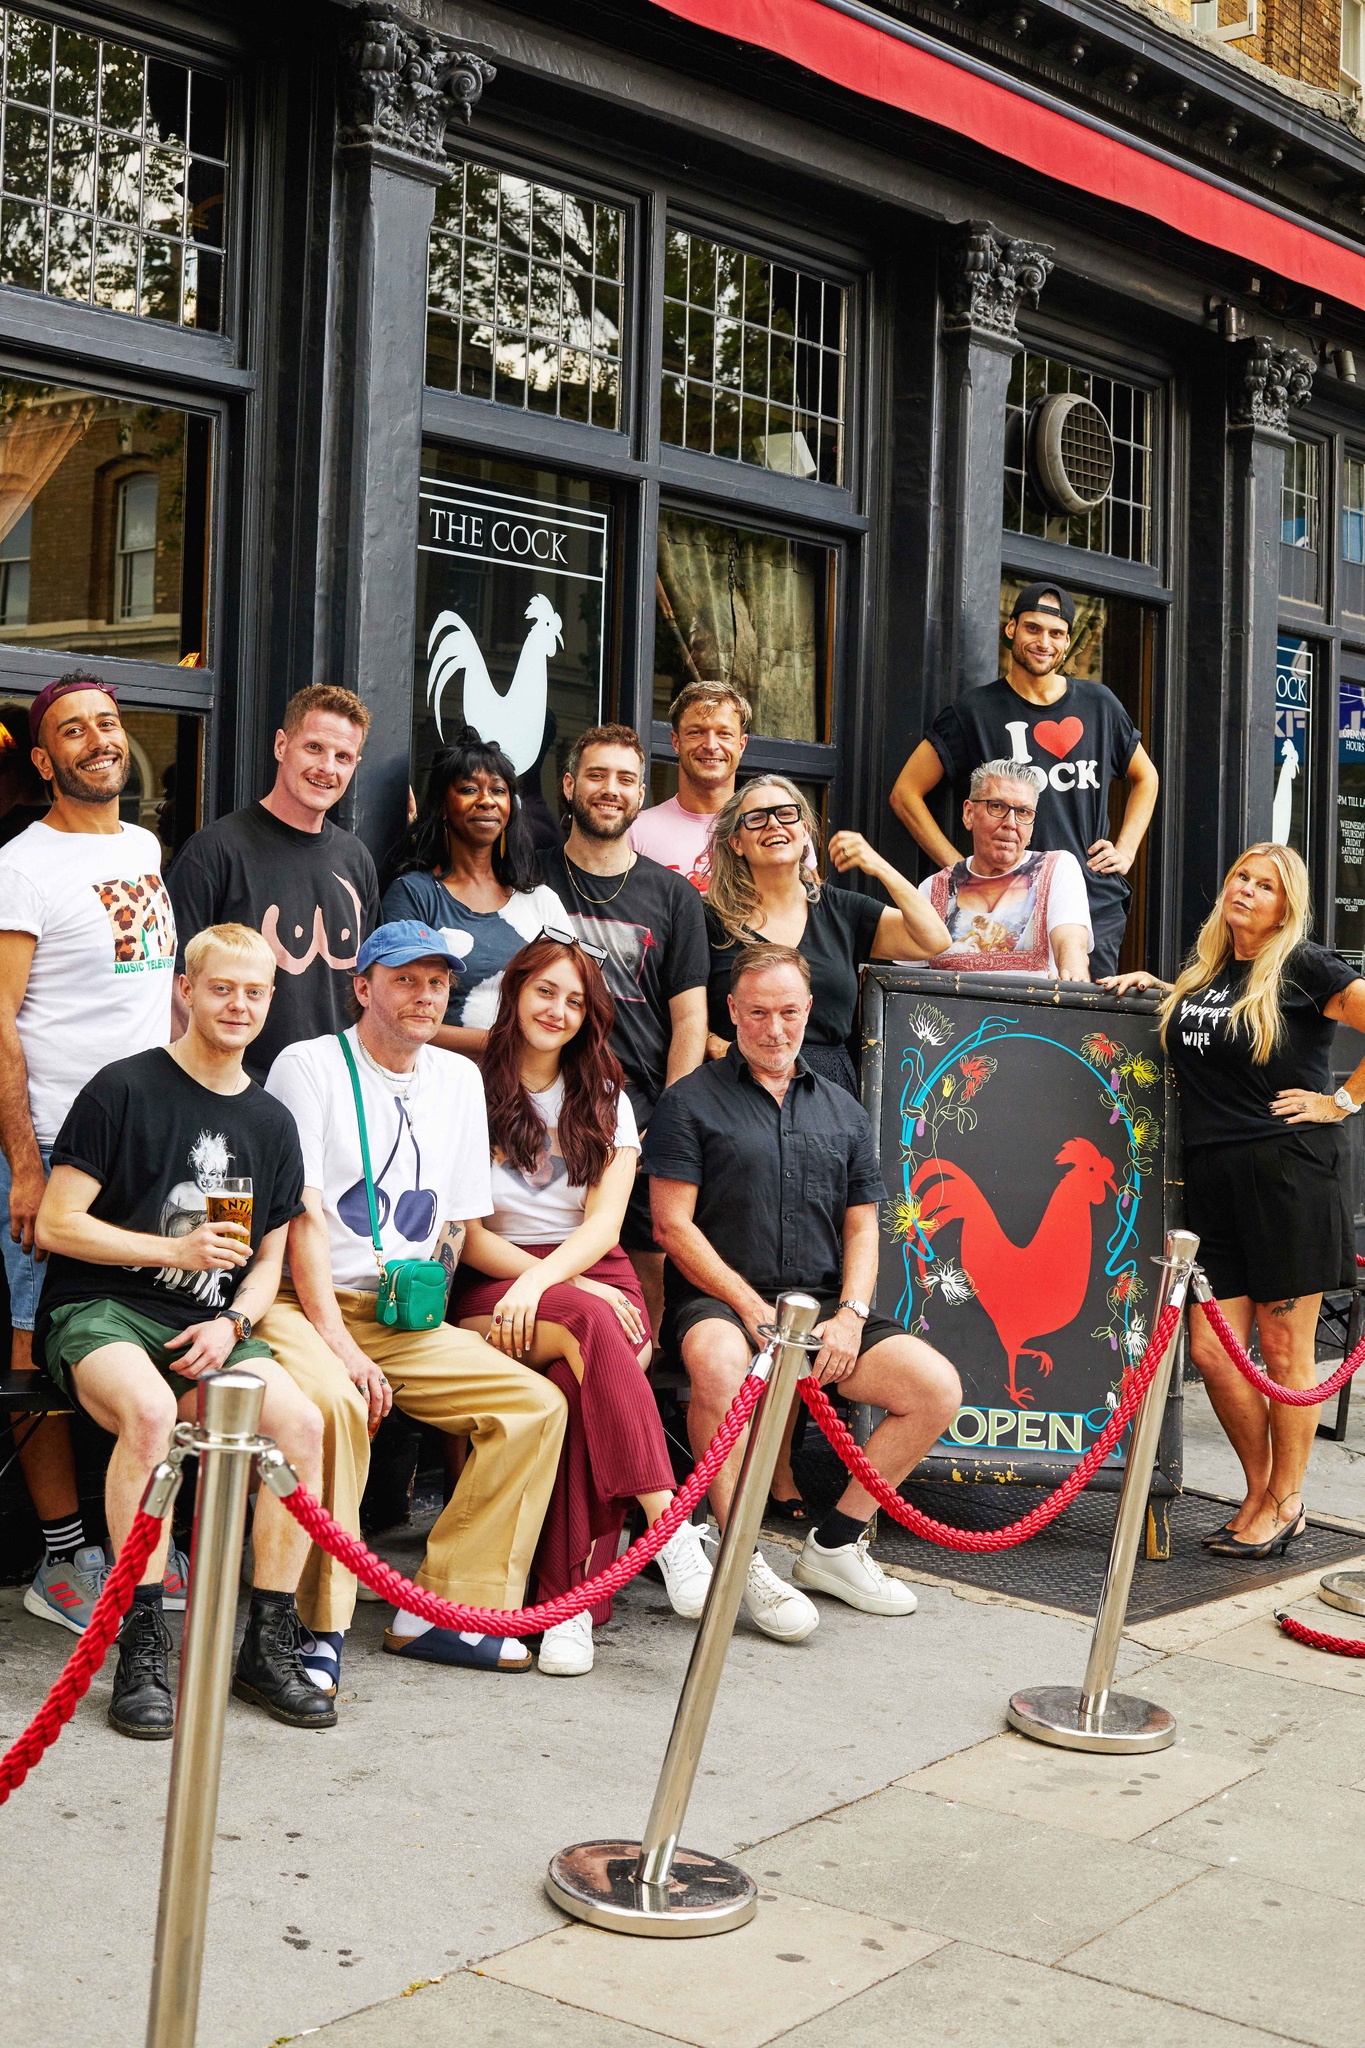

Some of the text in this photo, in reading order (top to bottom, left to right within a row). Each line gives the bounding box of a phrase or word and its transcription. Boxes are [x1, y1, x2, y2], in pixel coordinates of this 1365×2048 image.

[429, 507, 569, 565] THE COCK
[1275, 674, 1308, 703] OCK
[1004, 720, 1033, 764] I
[1346, 740, 1365, 752] HOURS
[1027, 759, 1101, 793] OCK
[1348, 796, 1359, 807] TILL
[1341, 846, 1364, 856] SATURDAY
[1345, 838, 1361, 847] FRIDAY
[1344, 855, 1362, 864] SUNDAY
[114, 960, 145, 974] MUSIC
[1201, 984, 1231, 1005] THE
[1182, 1031, 1211, 1056] WIFE
[949, 1406, 1083, 1453] OPEN
